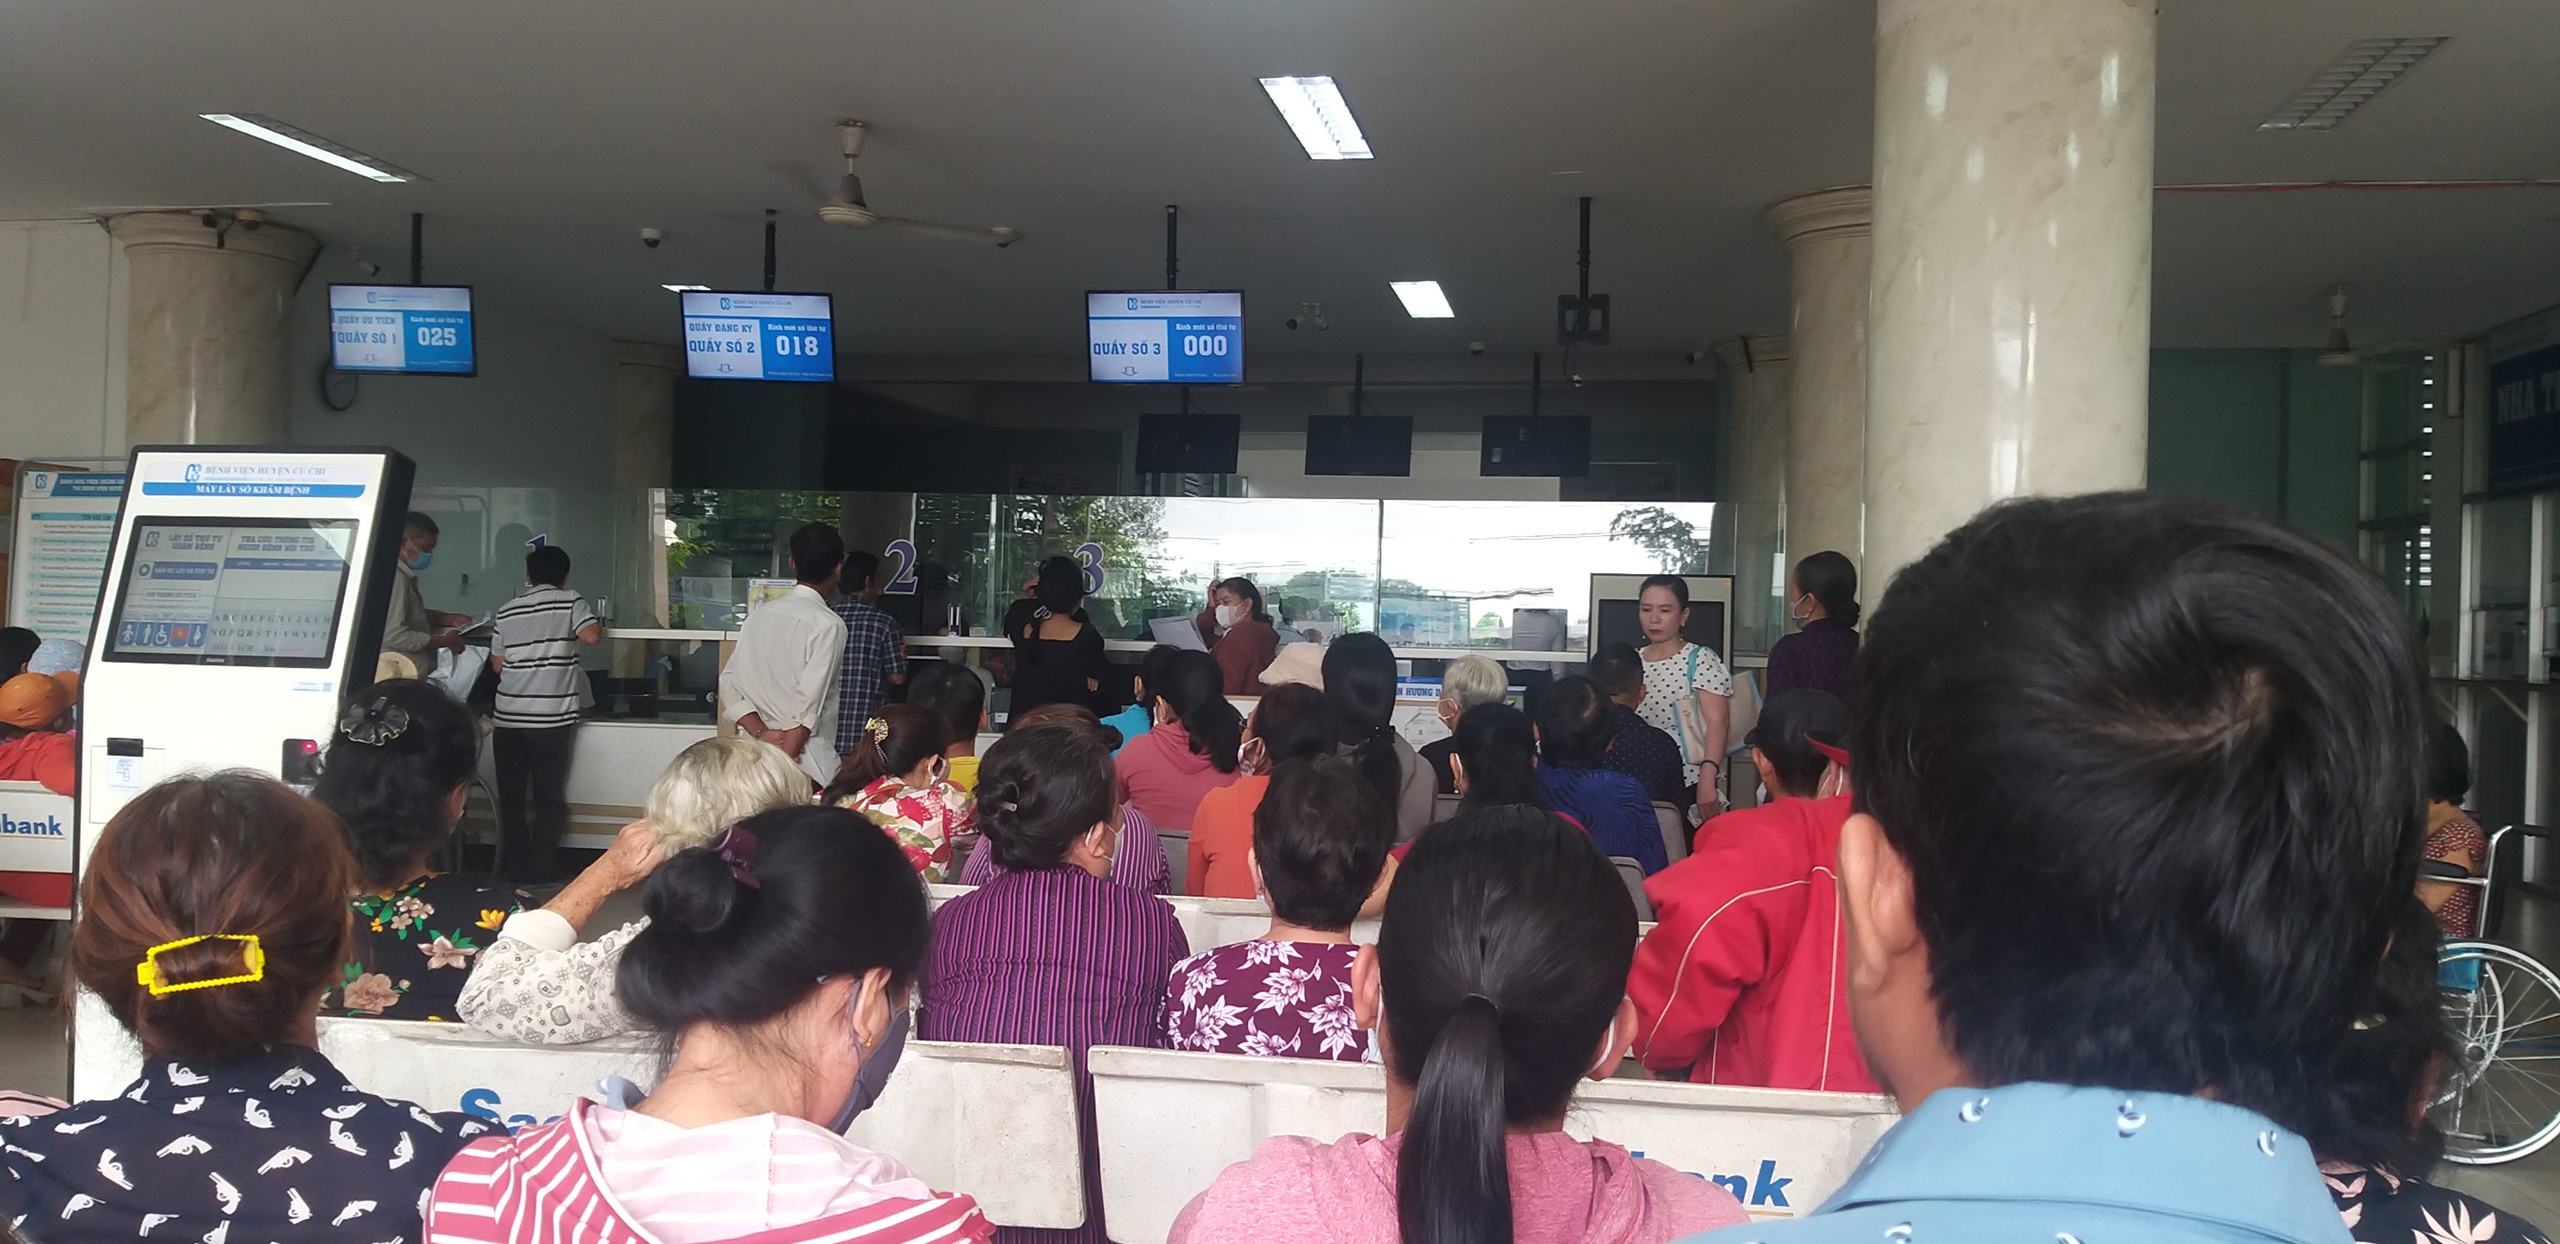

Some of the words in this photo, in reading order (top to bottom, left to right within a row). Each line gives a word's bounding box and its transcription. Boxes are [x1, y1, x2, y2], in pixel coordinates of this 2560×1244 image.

[392, 333, 397, 344] 1
[417, 326, 457, 346] 025
[726, 338, 743, 353] SỐ
[747, 341, 755, 353] 2
[776, 335, 819, 356] 018
[1184, 335, 1228, 356] 000
[1131, 339, 1148, 355] SỐ
[1153, 343, 1161, 355] 3
[205, 466, 231, 475] BỆNH
[233, 466, 255, 476] VIỆN
[257, 466, 290, 476] HUYỆN
[308, 467, 326, 476] CHI
[283, 485, 310, 495] BỆNH
[884, 539, 918, 595] 2
[1073, 542, 1105, 600] 3
[0, 812, 63, 836] bank
